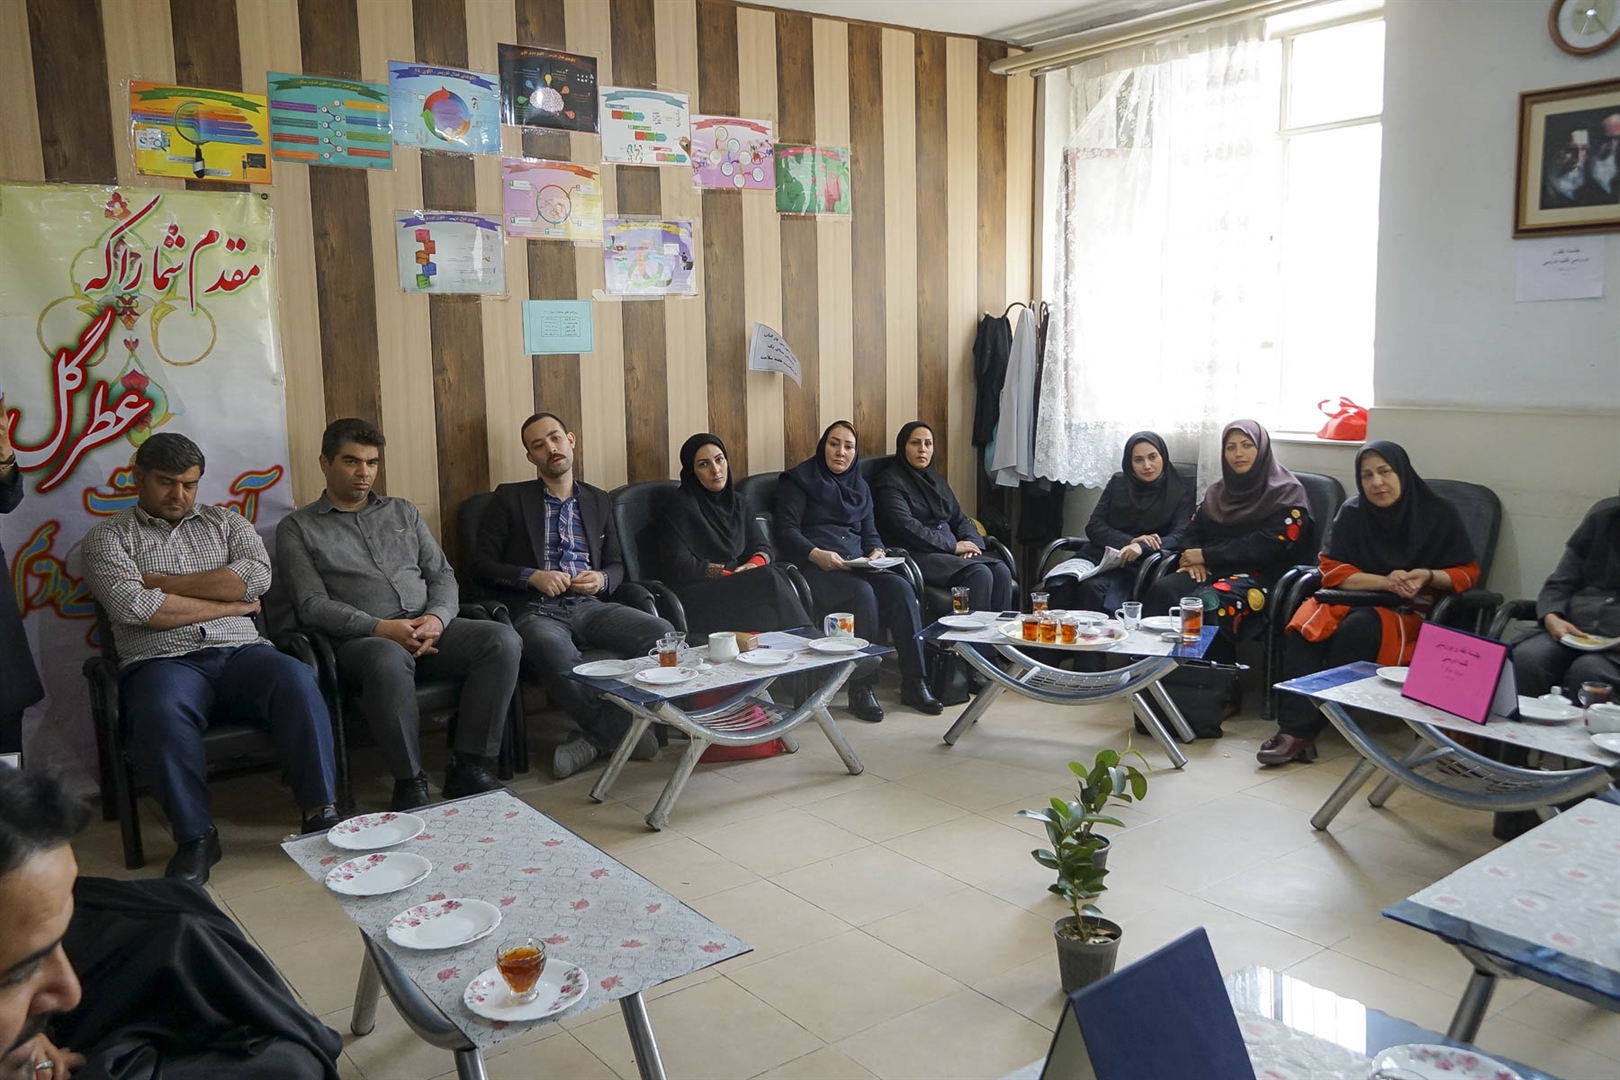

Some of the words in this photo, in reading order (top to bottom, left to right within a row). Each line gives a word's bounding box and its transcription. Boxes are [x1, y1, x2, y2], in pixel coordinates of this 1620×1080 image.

[152, 222, 187, 292] شما
[188, 228, 261, 313] مقدم
[7, 305, 117, 472] گل
[36, 380, 154, 493] عطر
